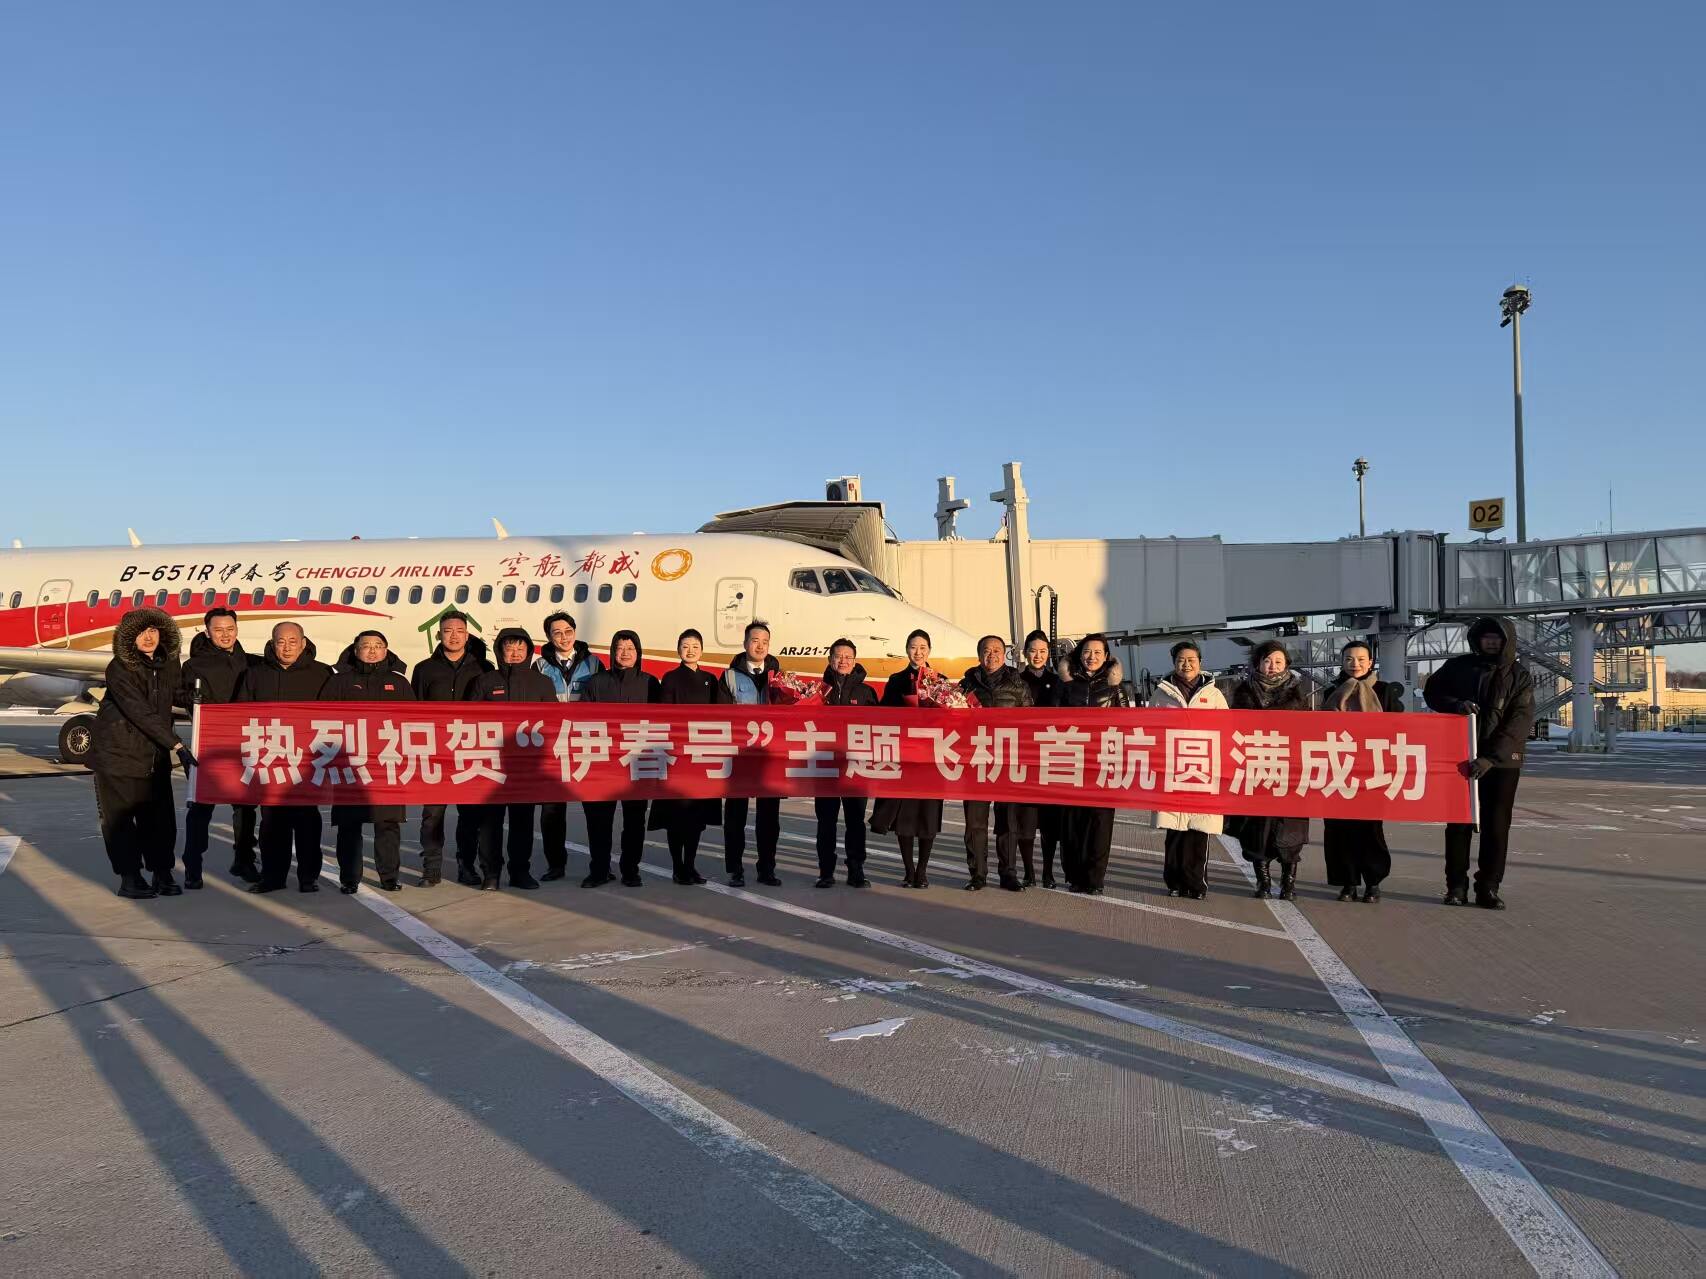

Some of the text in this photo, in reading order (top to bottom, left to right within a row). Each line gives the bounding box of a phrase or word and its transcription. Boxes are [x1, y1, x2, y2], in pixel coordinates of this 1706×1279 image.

[1473, 504, 1500, 523] 02
[120, 564, 215, 582] B-651R
[295, 565, 475, 579] CHENGDU AIRLINES
